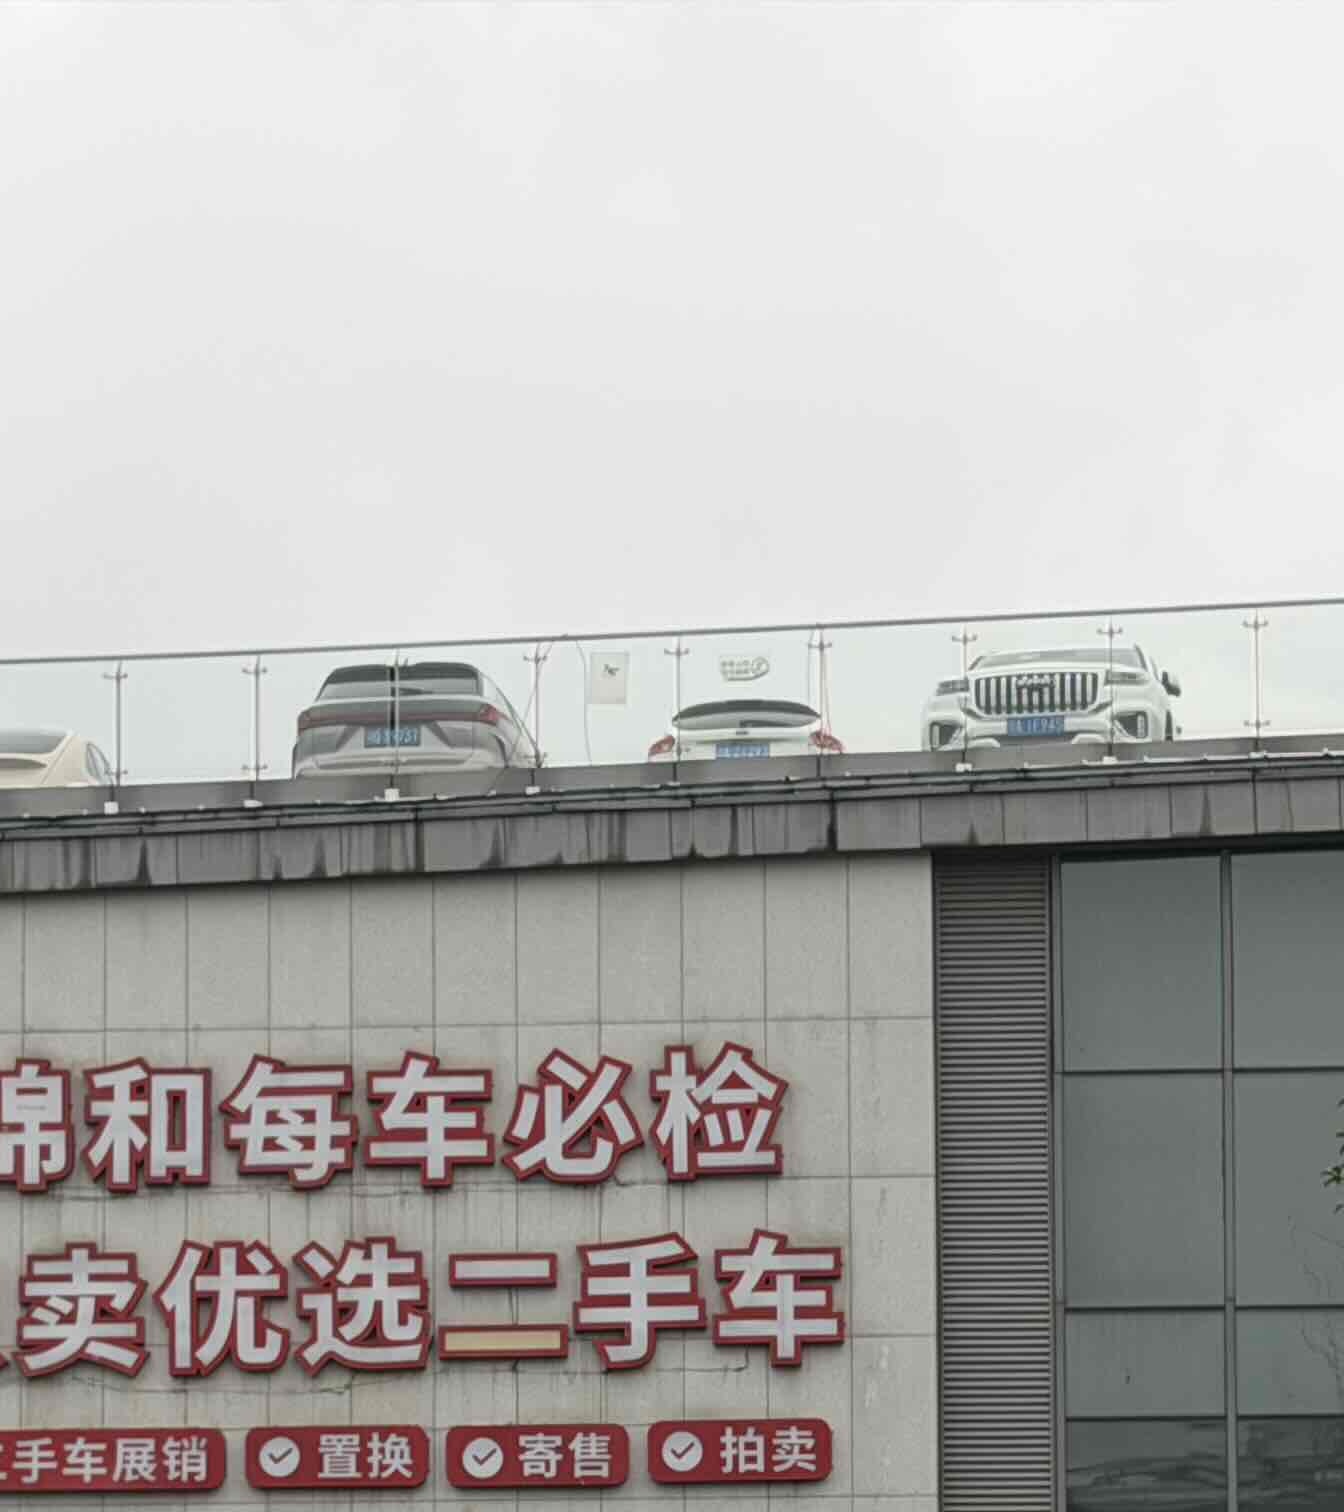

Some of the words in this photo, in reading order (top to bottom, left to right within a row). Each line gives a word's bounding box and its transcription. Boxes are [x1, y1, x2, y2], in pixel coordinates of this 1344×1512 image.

[316, 1432, 414, 1480] 置换
[517, 1429, 613, 1479] 寄售
[720, 1427, 818, 1476] 拍卖
